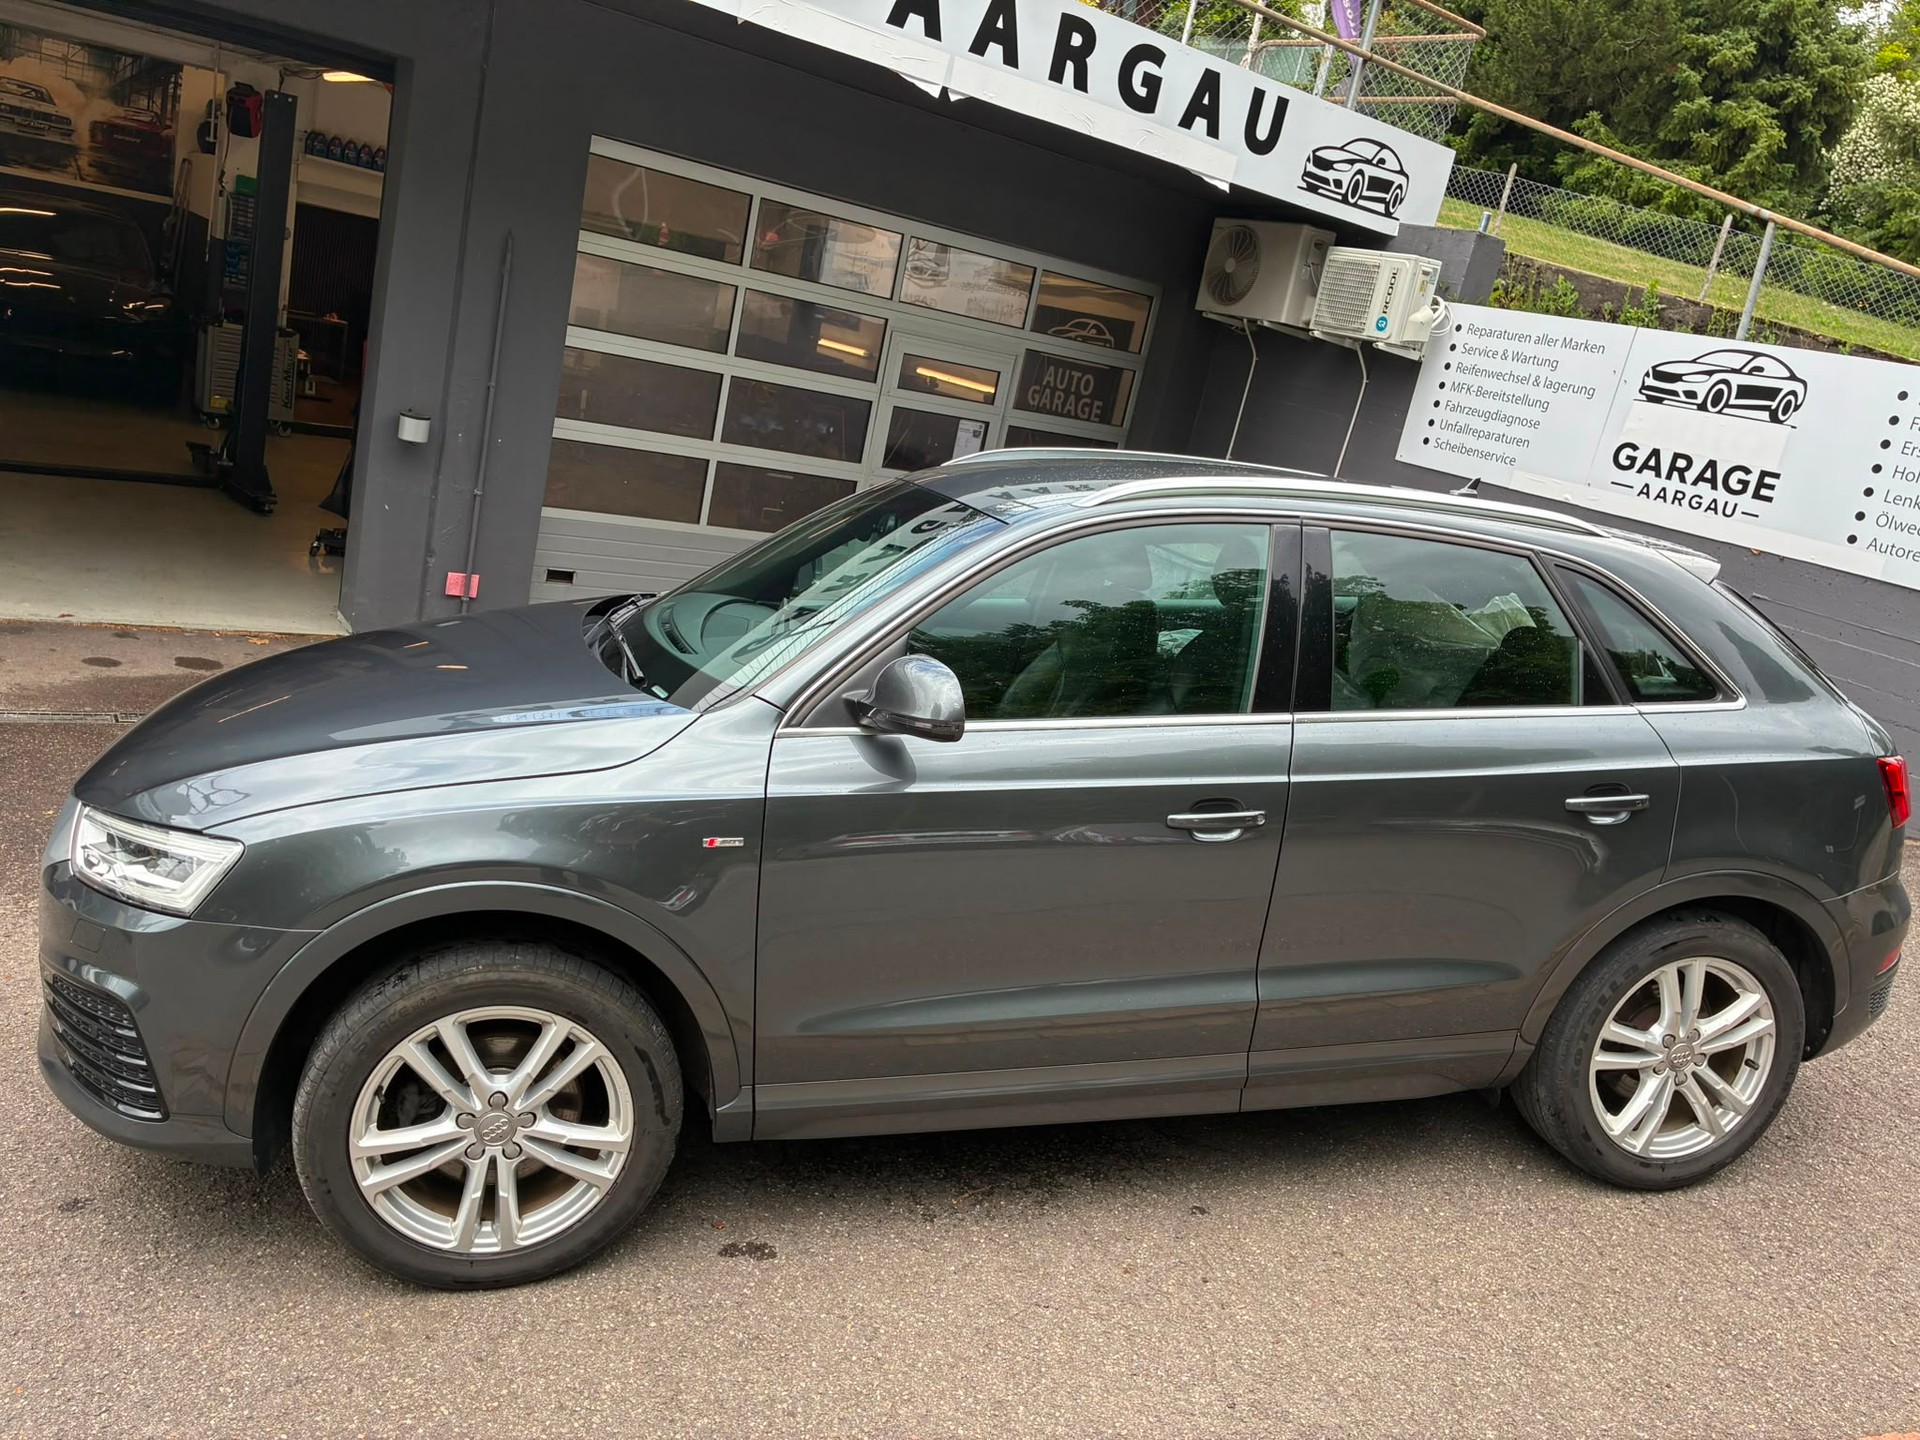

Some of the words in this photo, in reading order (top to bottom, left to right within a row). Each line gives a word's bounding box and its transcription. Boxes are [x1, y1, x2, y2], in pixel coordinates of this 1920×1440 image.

[1382, 267, 1399, 315] RCOOL
[1466, 323, 1532, 344] Reparaturen
[1533, 333, 1559, 347] aller
[1560, 336, 1606, 355] Marken
[1460, 342, 1499, 360] Service
[1500, 350, 1510, 361] &
[1511, 350, 1560, 372] Wartung
[1042, 365, 1094, 396] AUTO
[1455, 361, 1532, 386] Reifenwechsel
[1532, 375, 1542, 388] &
[1542, 378, 1597, 400] lagerung
[1027, 384, 1104, 422] GARAGE
[1449, 381, 1551, 414] MFK-Bereitstellung
[1444, 400, 1541, 430] Fahrzeugdiagnose
[1439, 418, 1531, 449] Unfallreparaturen
[1433, 437, 1518, 467] Scheibenservice
[1612, 441, 1782, 504] GARAGE
[1636, 482, 1739, 518] AARGAU
